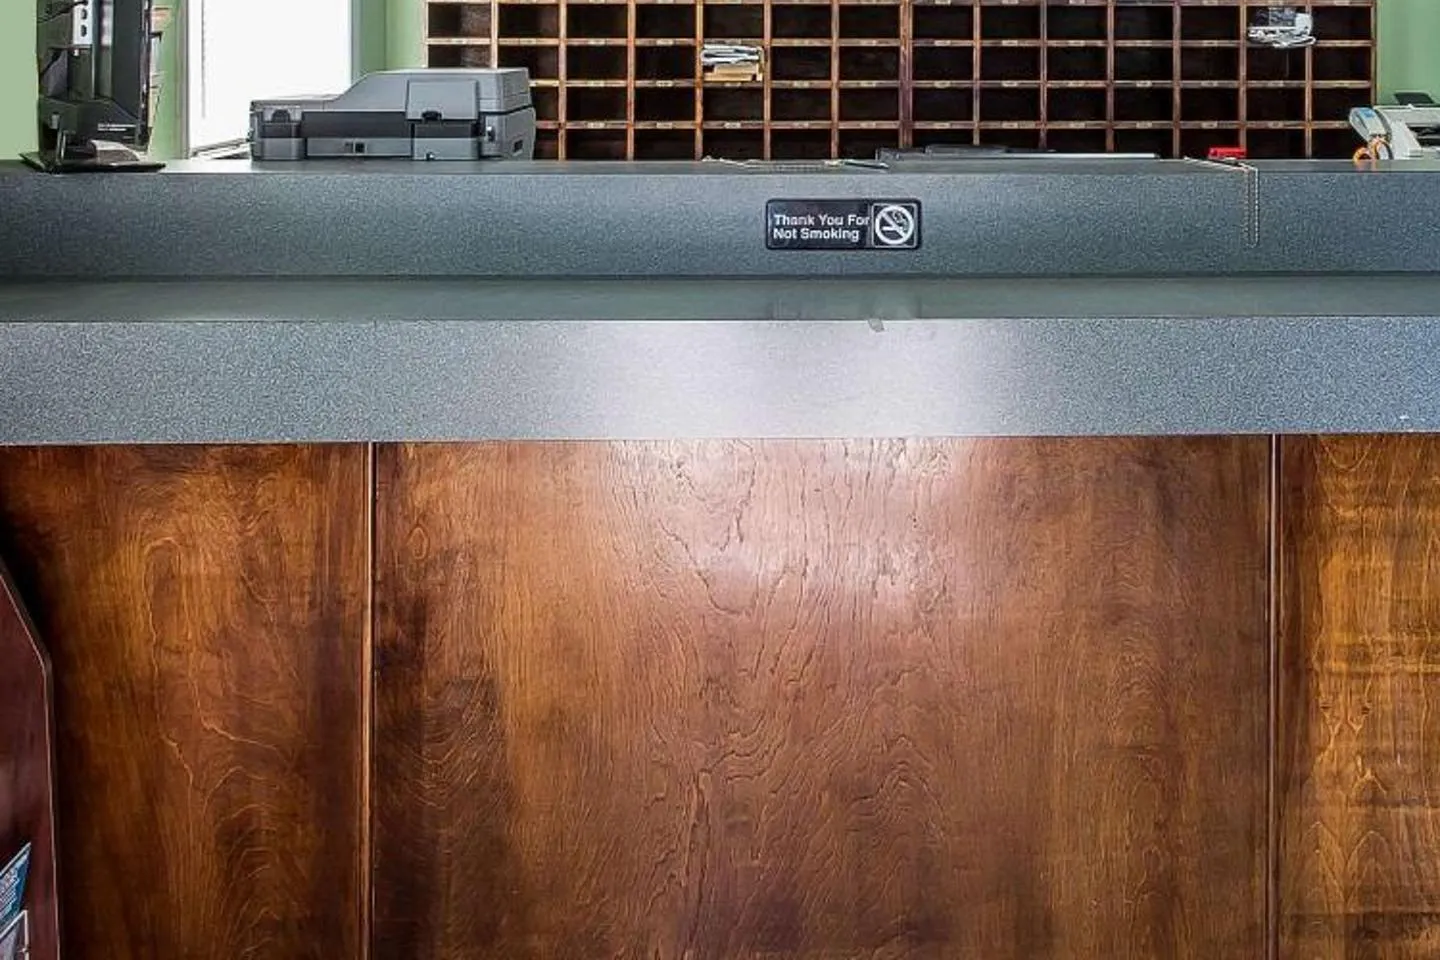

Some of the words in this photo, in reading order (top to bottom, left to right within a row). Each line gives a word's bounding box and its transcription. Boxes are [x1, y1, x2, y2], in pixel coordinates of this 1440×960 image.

[773, 214, 815, 226] Thank
[819, 214, 843, 226] You
[848, 214, 870, 226] For
[773, 228, 797, 239] Not
[800, 228, 859, 243] Smoking
